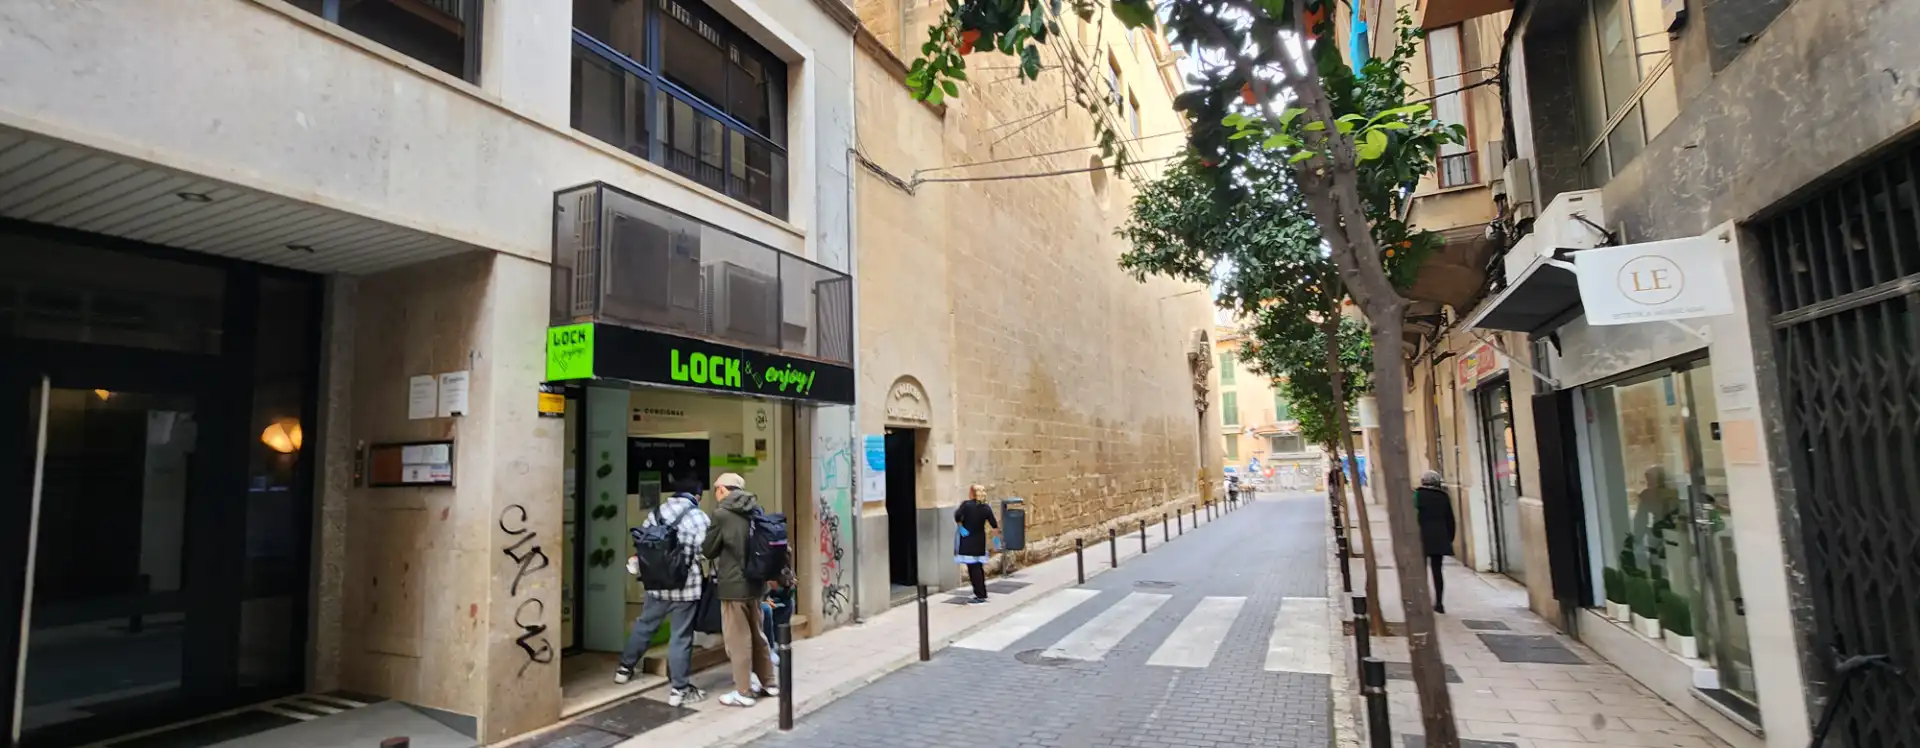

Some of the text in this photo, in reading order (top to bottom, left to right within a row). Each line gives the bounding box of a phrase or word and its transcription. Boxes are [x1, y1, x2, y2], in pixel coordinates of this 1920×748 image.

[1630, 268, 1672, 292] LE
[553, 329, 586, 347] LOCK
[670, 348, 741, 388] LOCK
[765, 362, 816, 396] enjoy!
